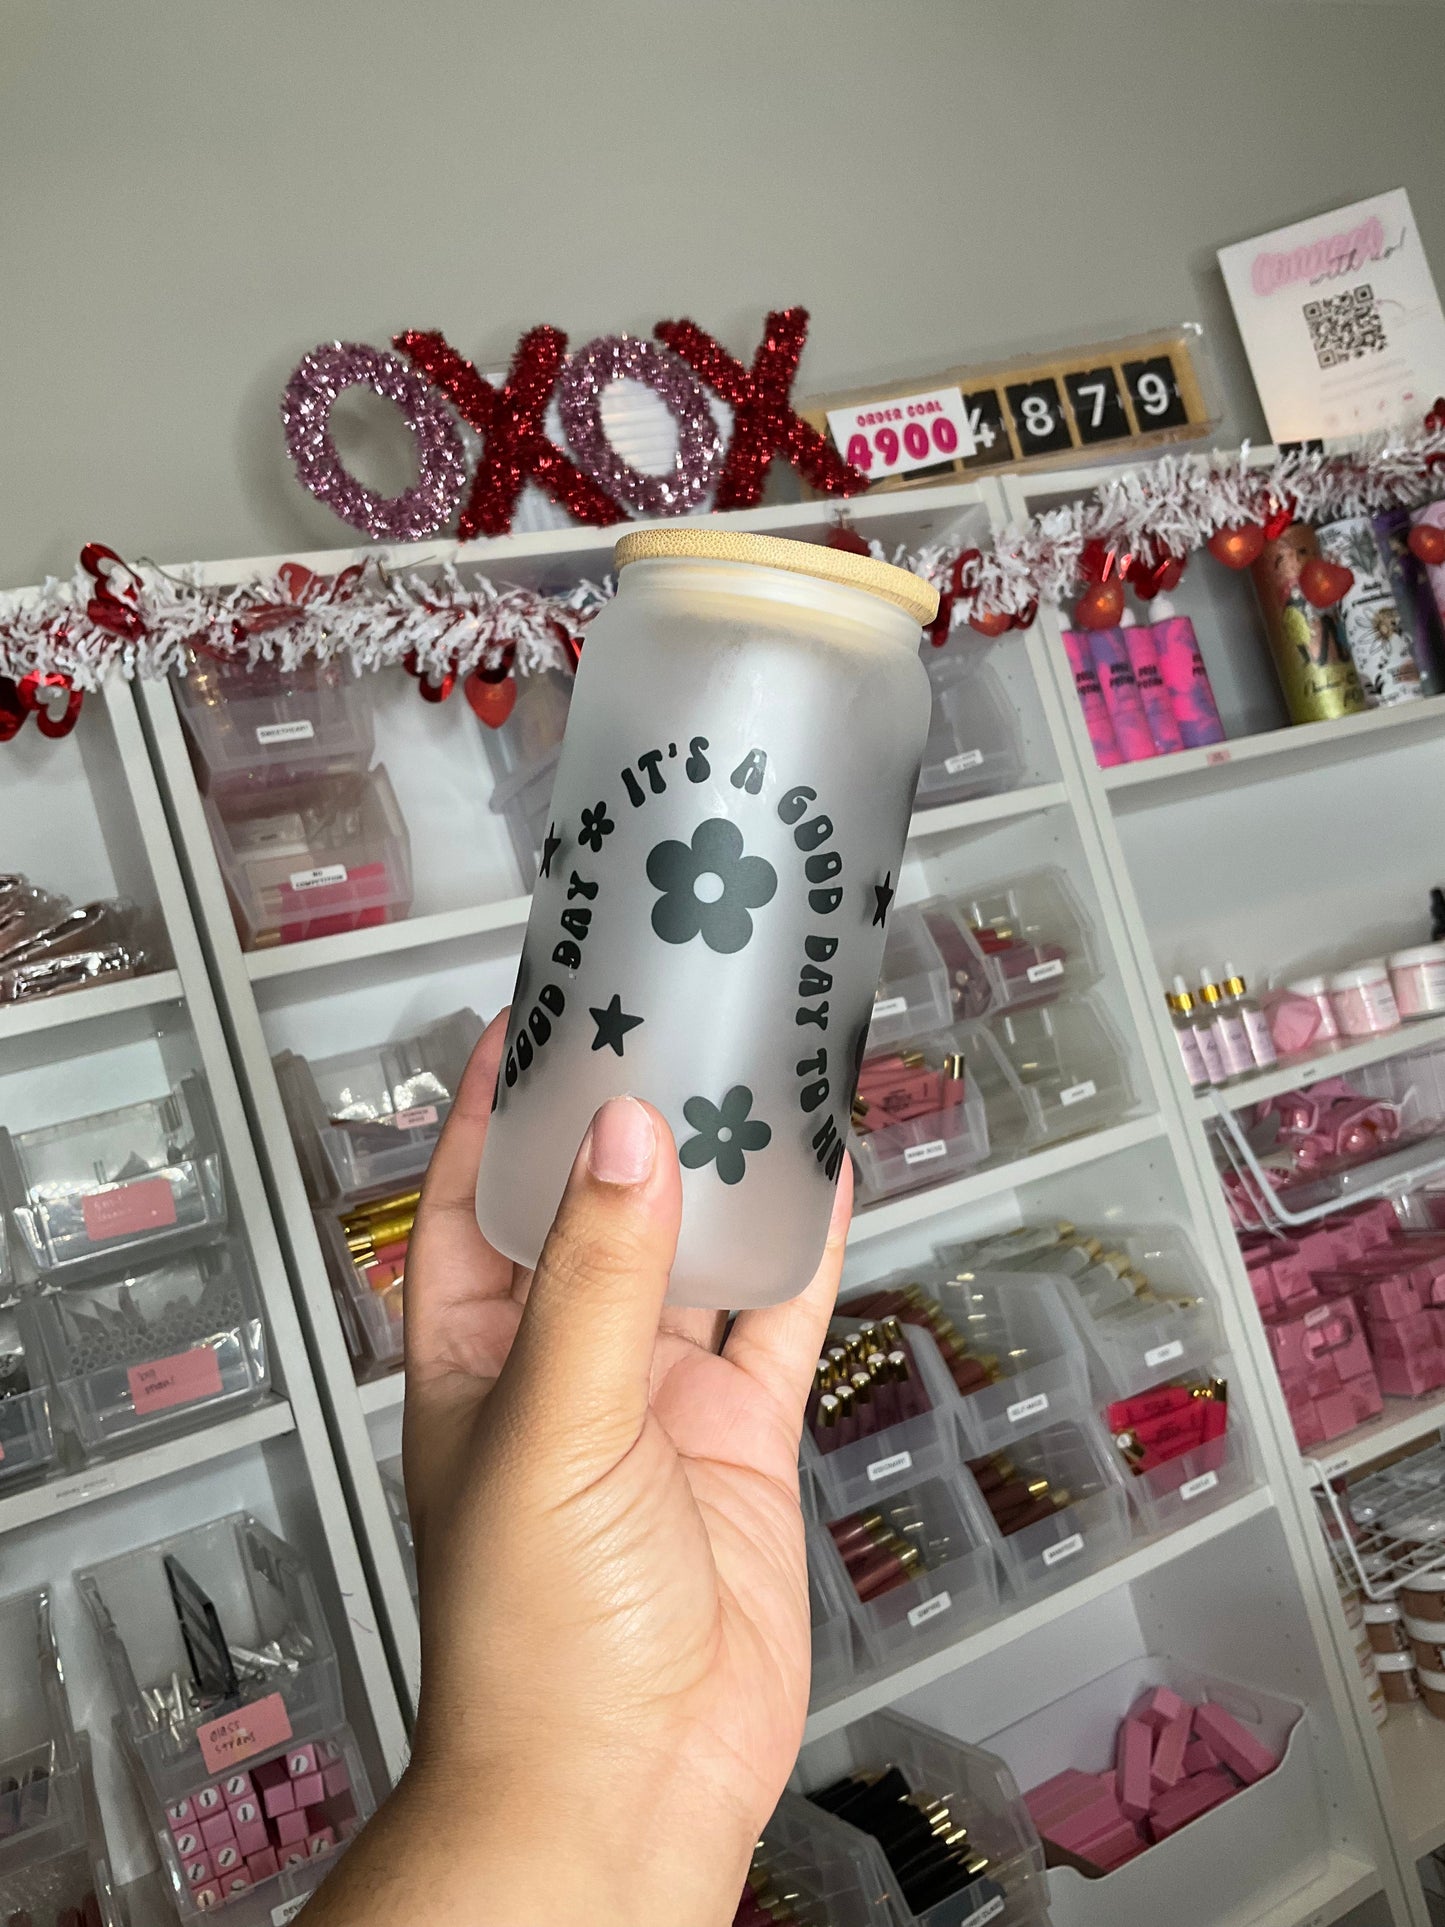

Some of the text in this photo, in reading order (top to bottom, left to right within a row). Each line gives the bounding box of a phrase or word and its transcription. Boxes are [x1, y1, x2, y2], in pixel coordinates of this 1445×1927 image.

[846, 417, 958, 472] 4900
[856, 408, 903, 427] ORDER
[620, 736, 711, 808] IT'S
[730, 748, 768, 795] A
[777, 785, 843, 914] GOOD
[505, 870, 599, 1088] GOOD DAY
[795, 934, 839, 1031] DAY
[796, 1047, 830, 1113] TO
